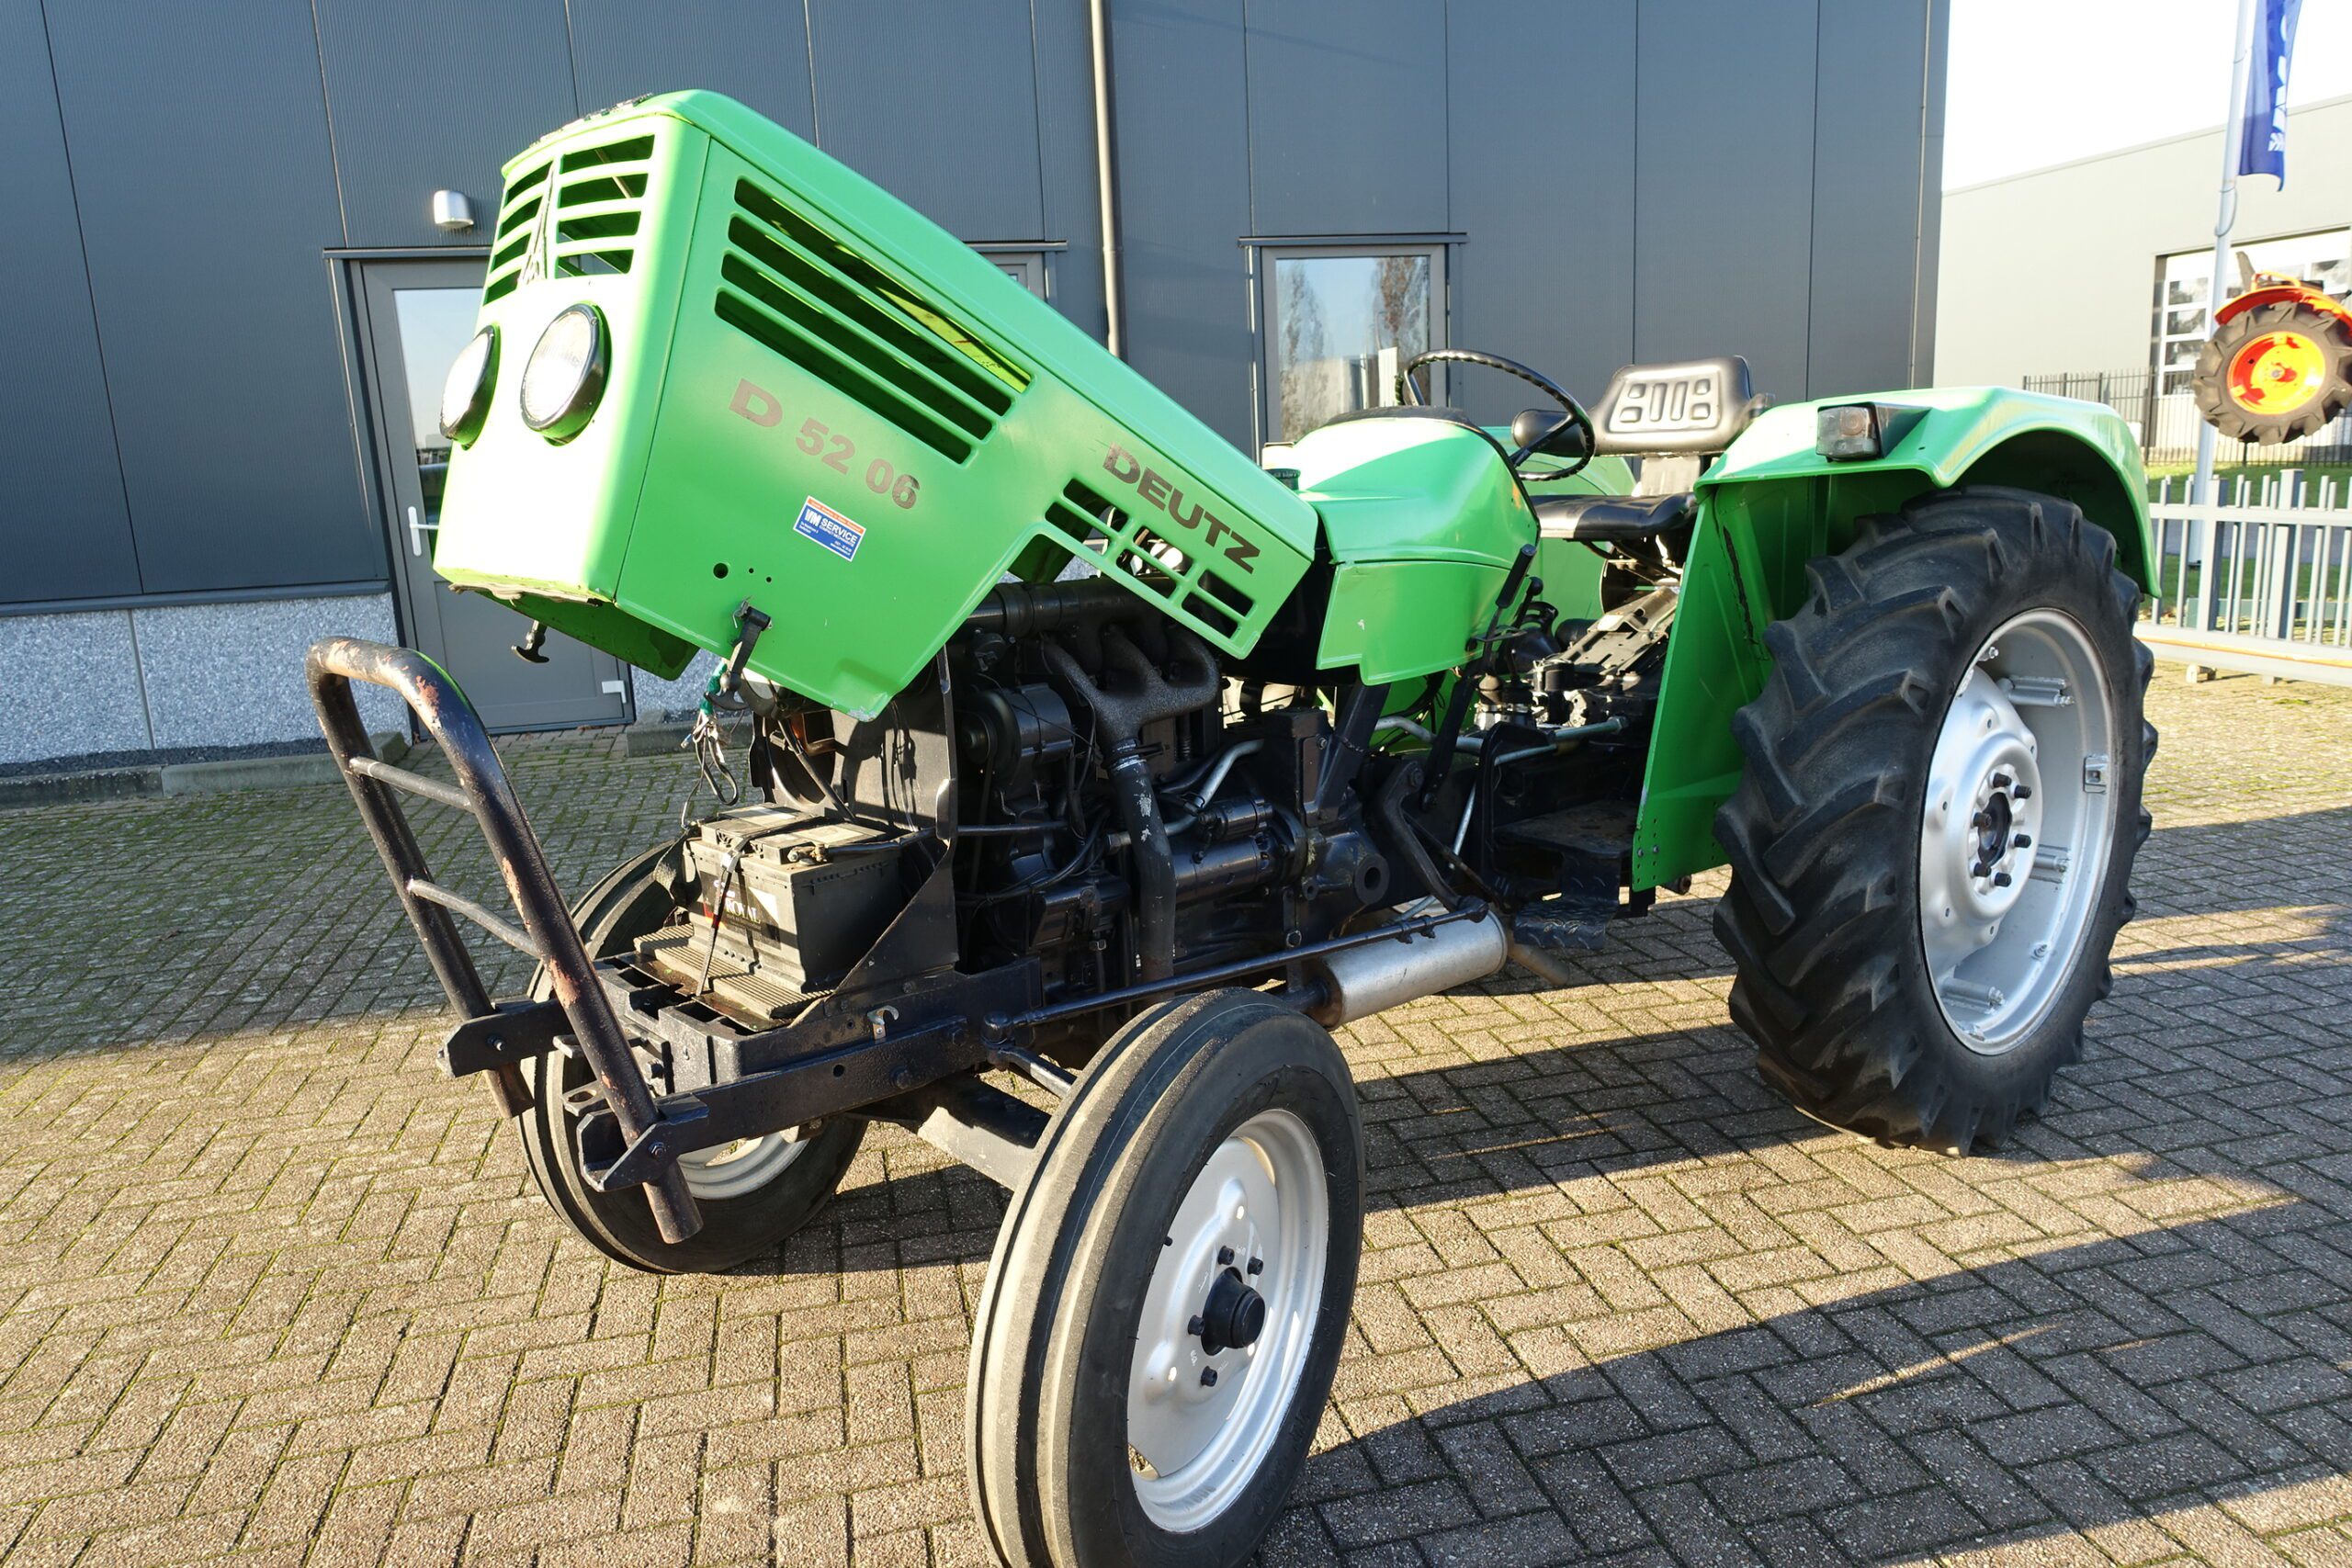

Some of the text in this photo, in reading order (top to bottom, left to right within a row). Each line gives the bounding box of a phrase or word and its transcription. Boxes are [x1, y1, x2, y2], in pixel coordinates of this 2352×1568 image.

[729, 378, 920, 509] D 52 06
[821, 518, 857, 544] SERVICE
[1103, 442, 1261, 574] DEUTZ
[725, 897, 761, 924] ROYAL
